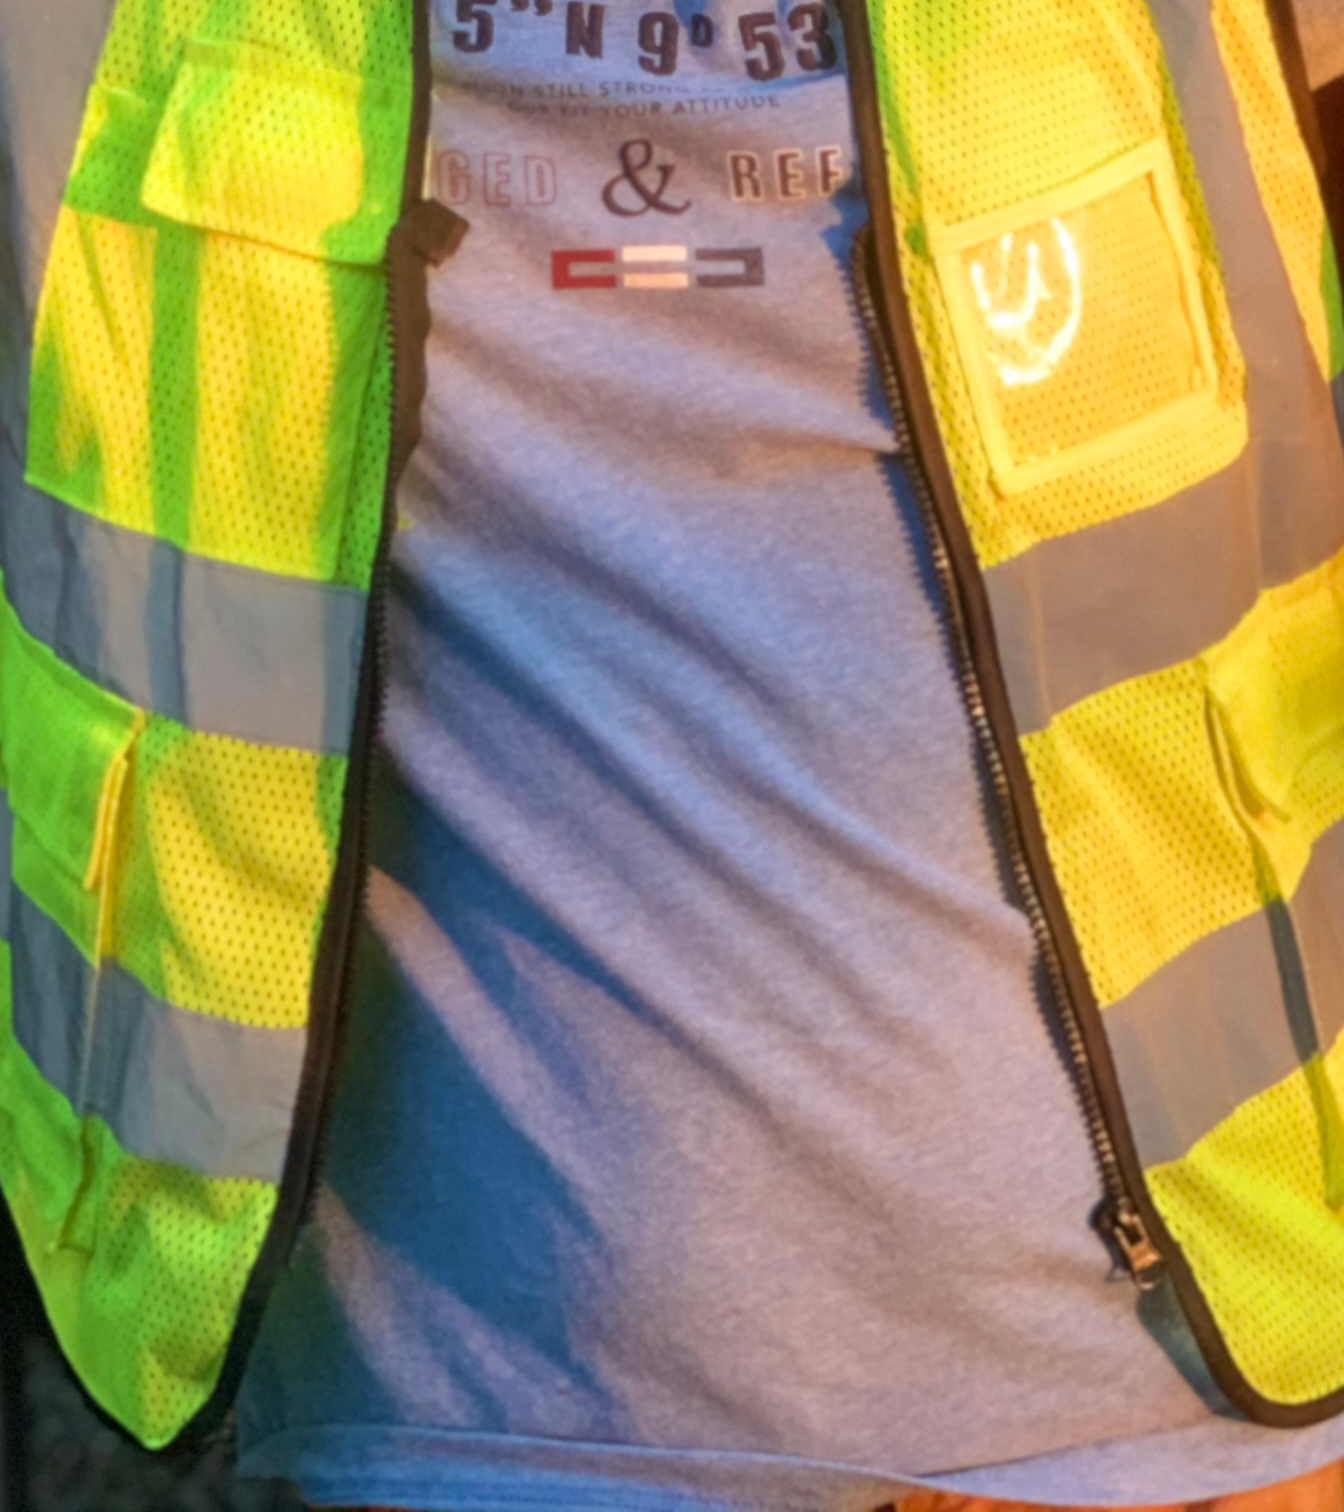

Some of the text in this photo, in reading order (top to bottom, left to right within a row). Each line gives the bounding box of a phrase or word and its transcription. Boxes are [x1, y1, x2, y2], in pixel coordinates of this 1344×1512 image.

[565, 0, 606, 58] N
[534, 82, 589, 99] STILL
[600, 100, 662, 118] YOUR
[672, 94, 781, 116] ATTITUDE
[601, 138, 692, 218] &
